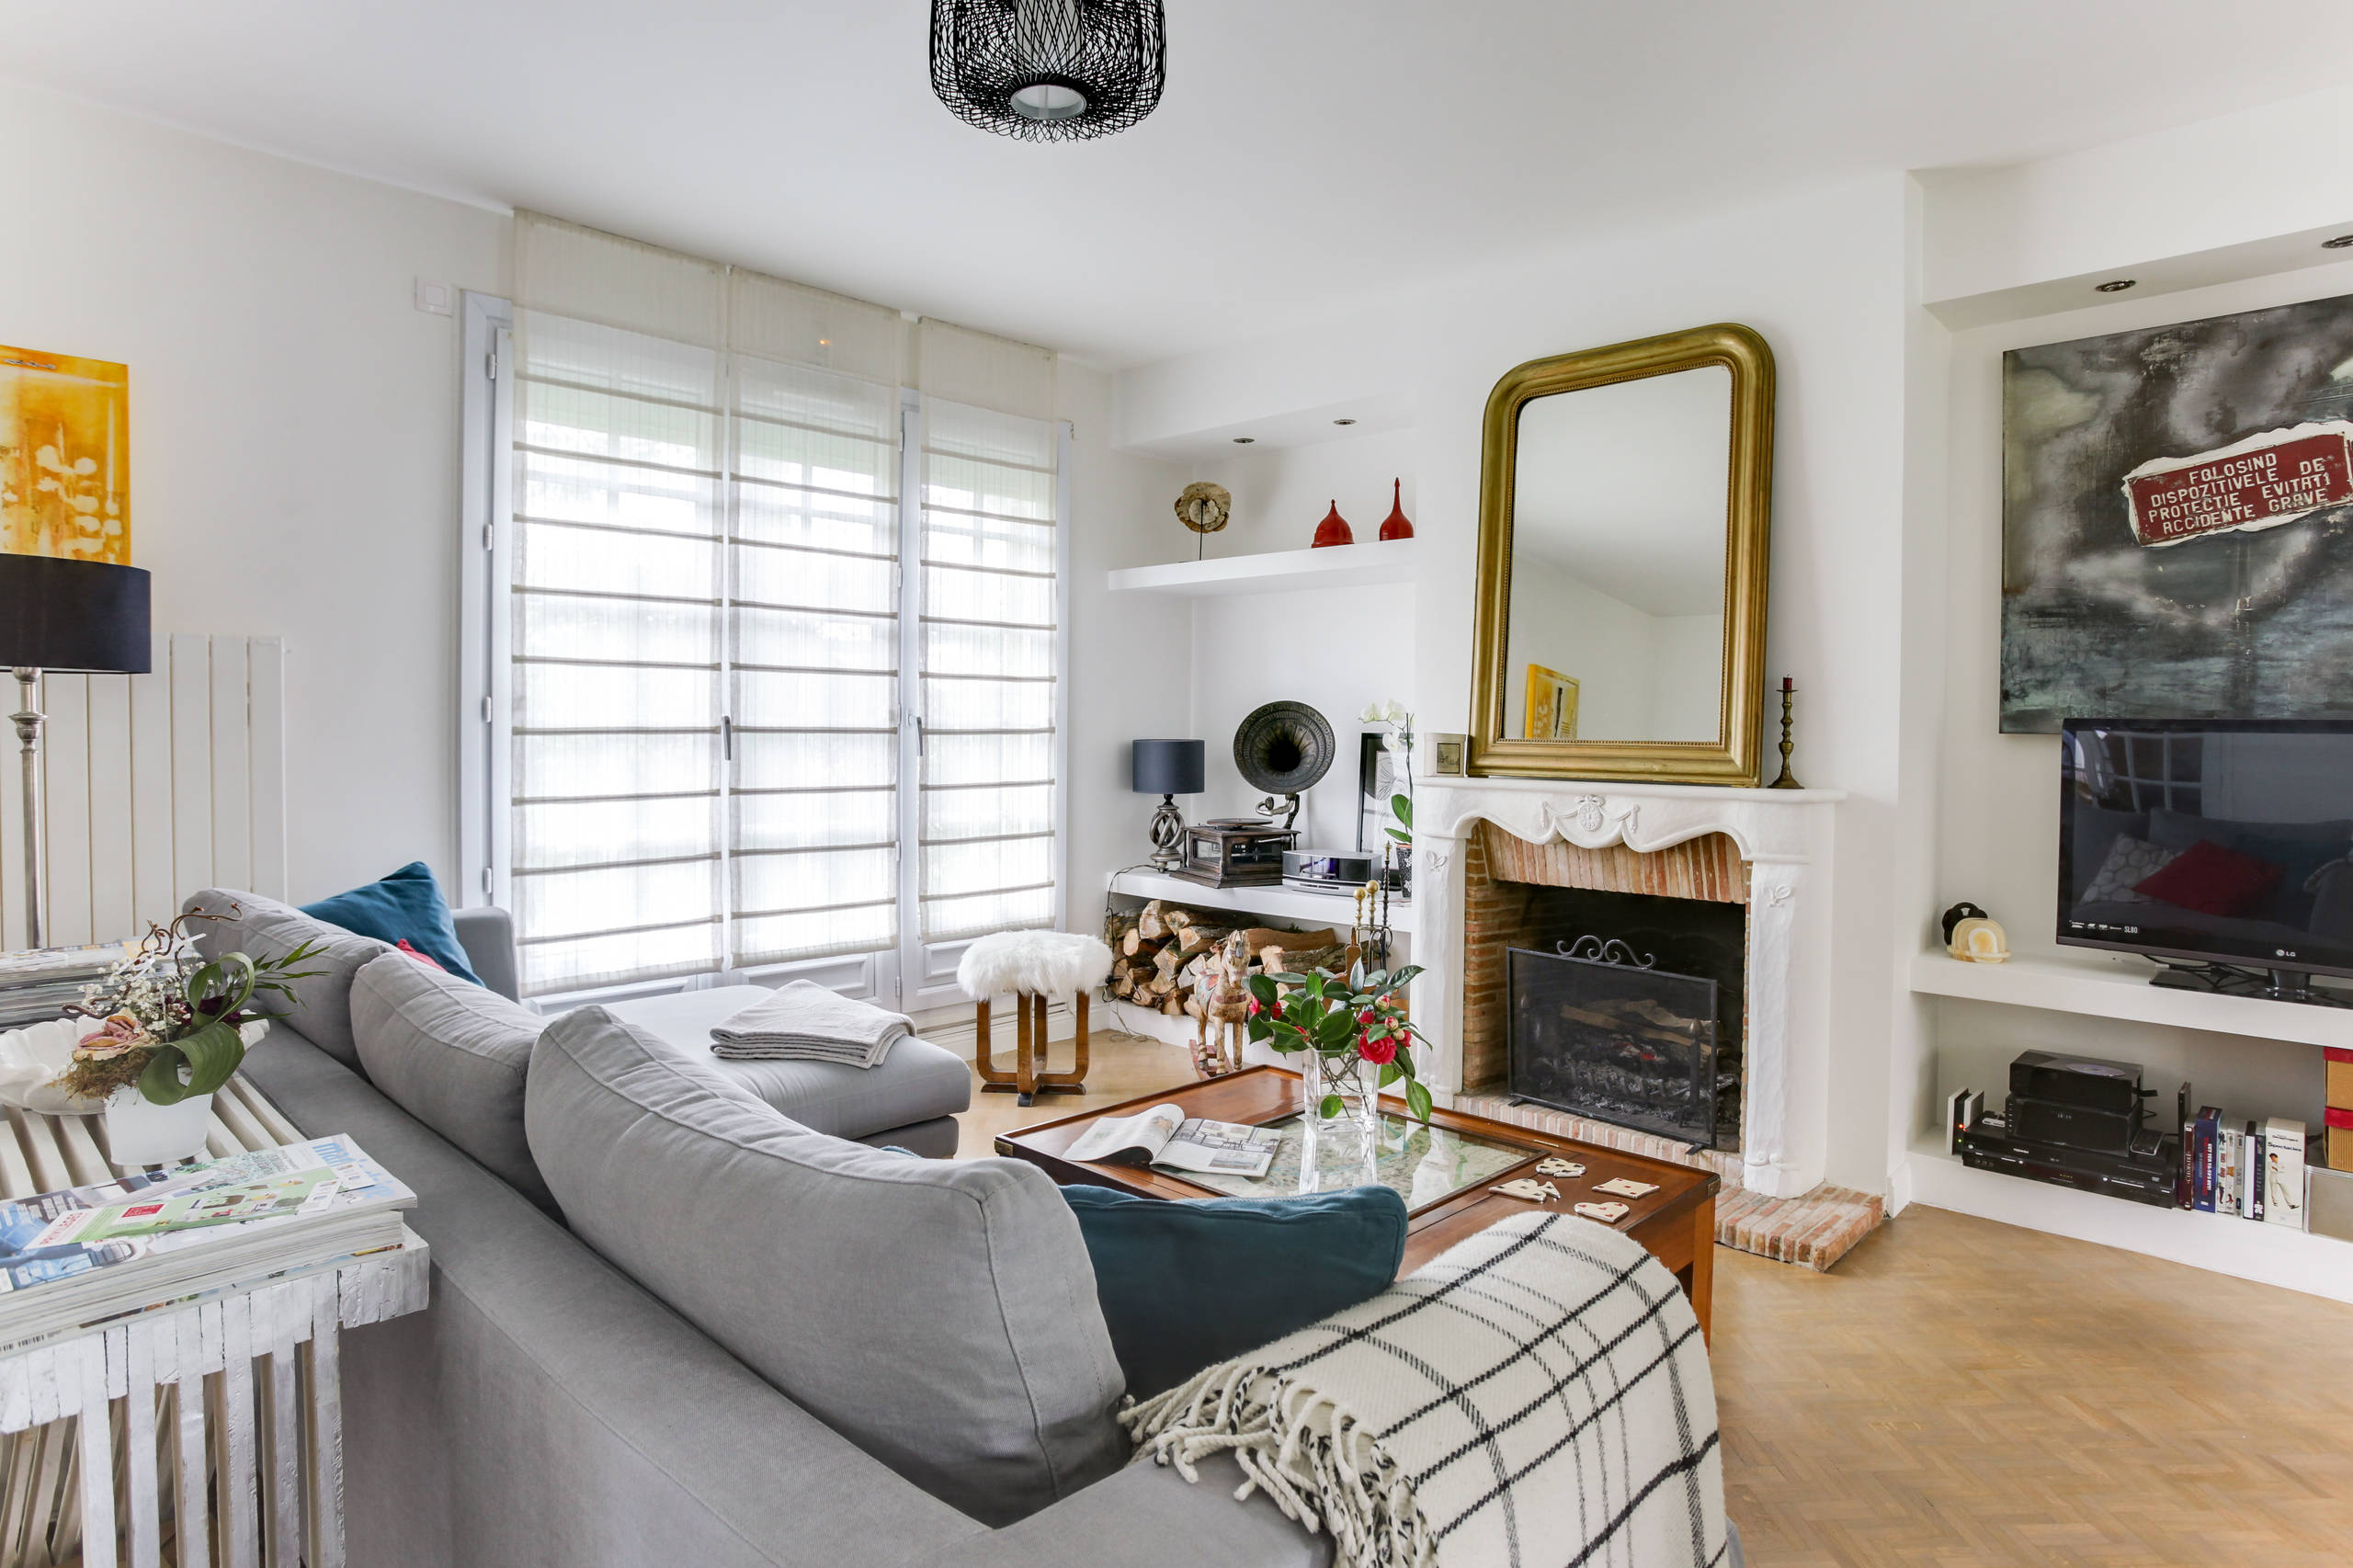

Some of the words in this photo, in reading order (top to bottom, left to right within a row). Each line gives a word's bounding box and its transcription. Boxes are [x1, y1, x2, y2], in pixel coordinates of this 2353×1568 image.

[2150, 468, 2279, 507] DISPOZITIVELE
[2299, 457, 2325, 475] DE
[2188, 453, 2278, 485] FOLOSIND
[2148, 492, 2240, 523] PROTECTIE
[2163, 504, 2256, 534] ACCIDENTE
[2268, 488, 2328, 513] GRAVE
